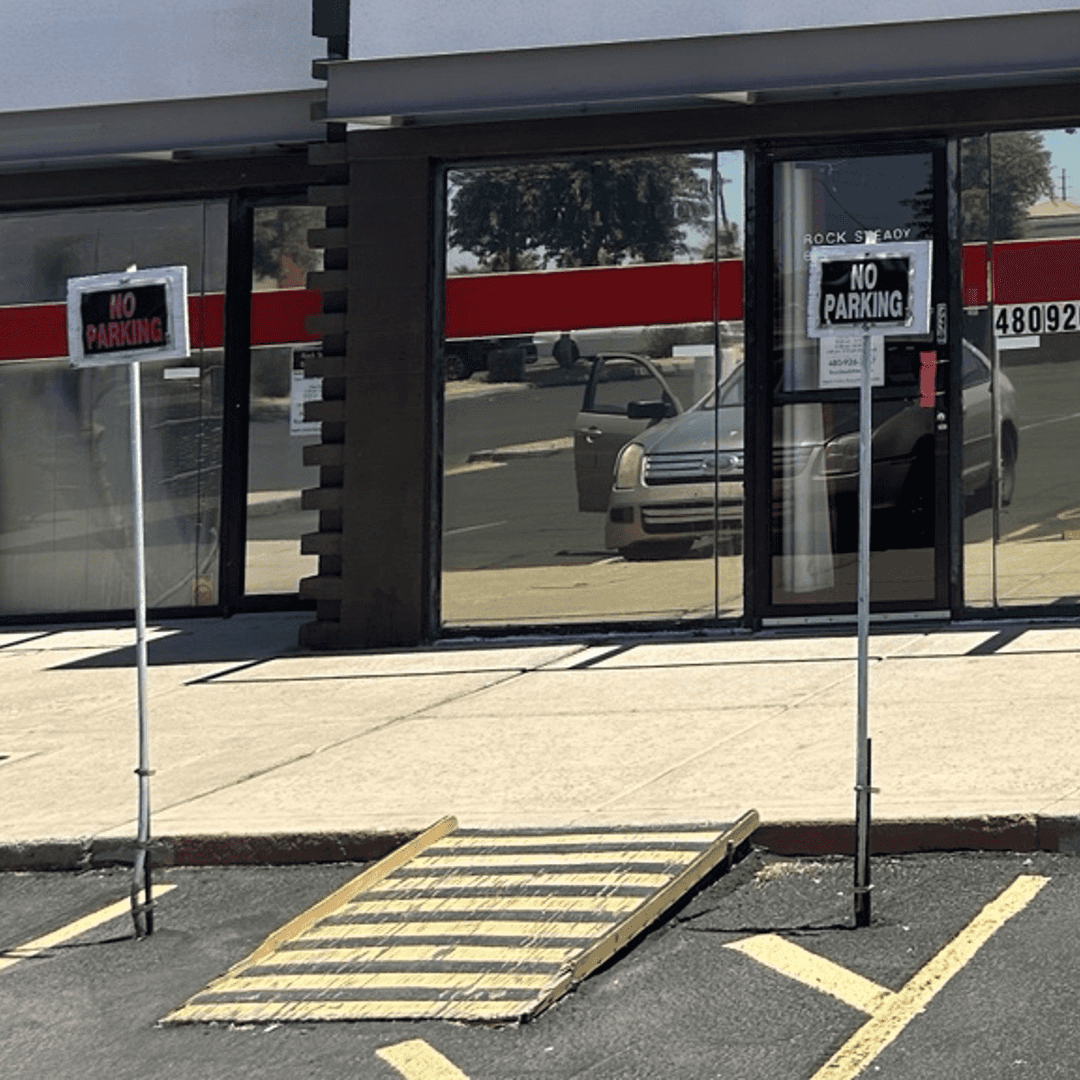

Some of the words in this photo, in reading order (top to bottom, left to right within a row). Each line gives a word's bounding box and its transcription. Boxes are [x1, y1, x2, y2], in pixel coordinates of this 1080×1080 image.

[803, 231, 847, 245] ROCK
[851, 262, 878, 291] NO
[109, 291, 136, 319] NO
[824, 290, 903, 320] PARKING
[86, 317, 162, 351] PARKING
